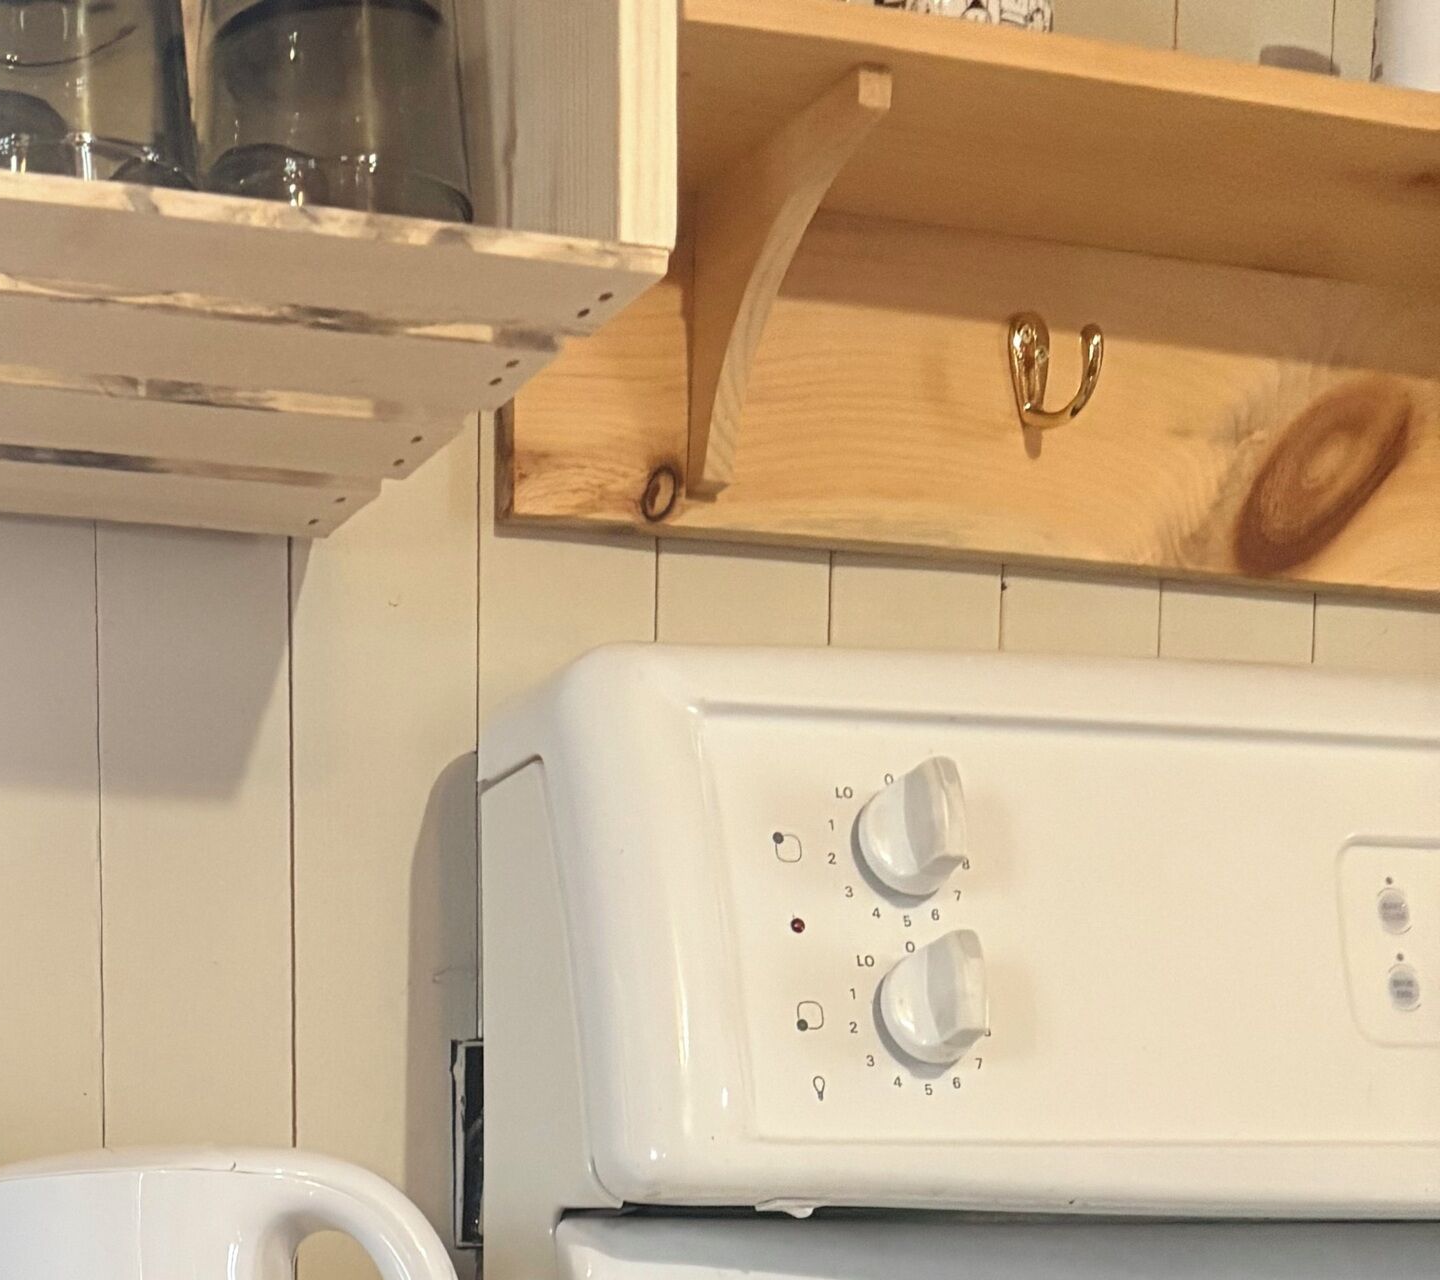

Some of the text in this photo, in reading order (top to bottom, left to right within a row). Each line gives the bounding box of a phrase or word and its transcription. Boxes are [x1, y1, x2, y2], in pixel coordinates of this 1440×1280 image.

[835, 786, 854, 799] LO
[828, 819, 835, 831] 1
[827, 852, 837, 865] 2
[844, 886, 854, 898] 3
[953, 890, 962, 902] 7
[872, 907, 881, 919] 4
[931, 908, 940, 921] 6
[903, 915, 912, 928] 5
[856, 954, 875, 967] LO
[849, 988, 856, 1000] 1
[849, 1021, 859, 1034] 2
[866, 1055, 875, 1067] 3
[975, 1058, 983, 1070] 7
[893, 1076, 902, 1088] 4
[952, 1076, 961, 1089] 6
[924, 1083, 933, 1096] 5
